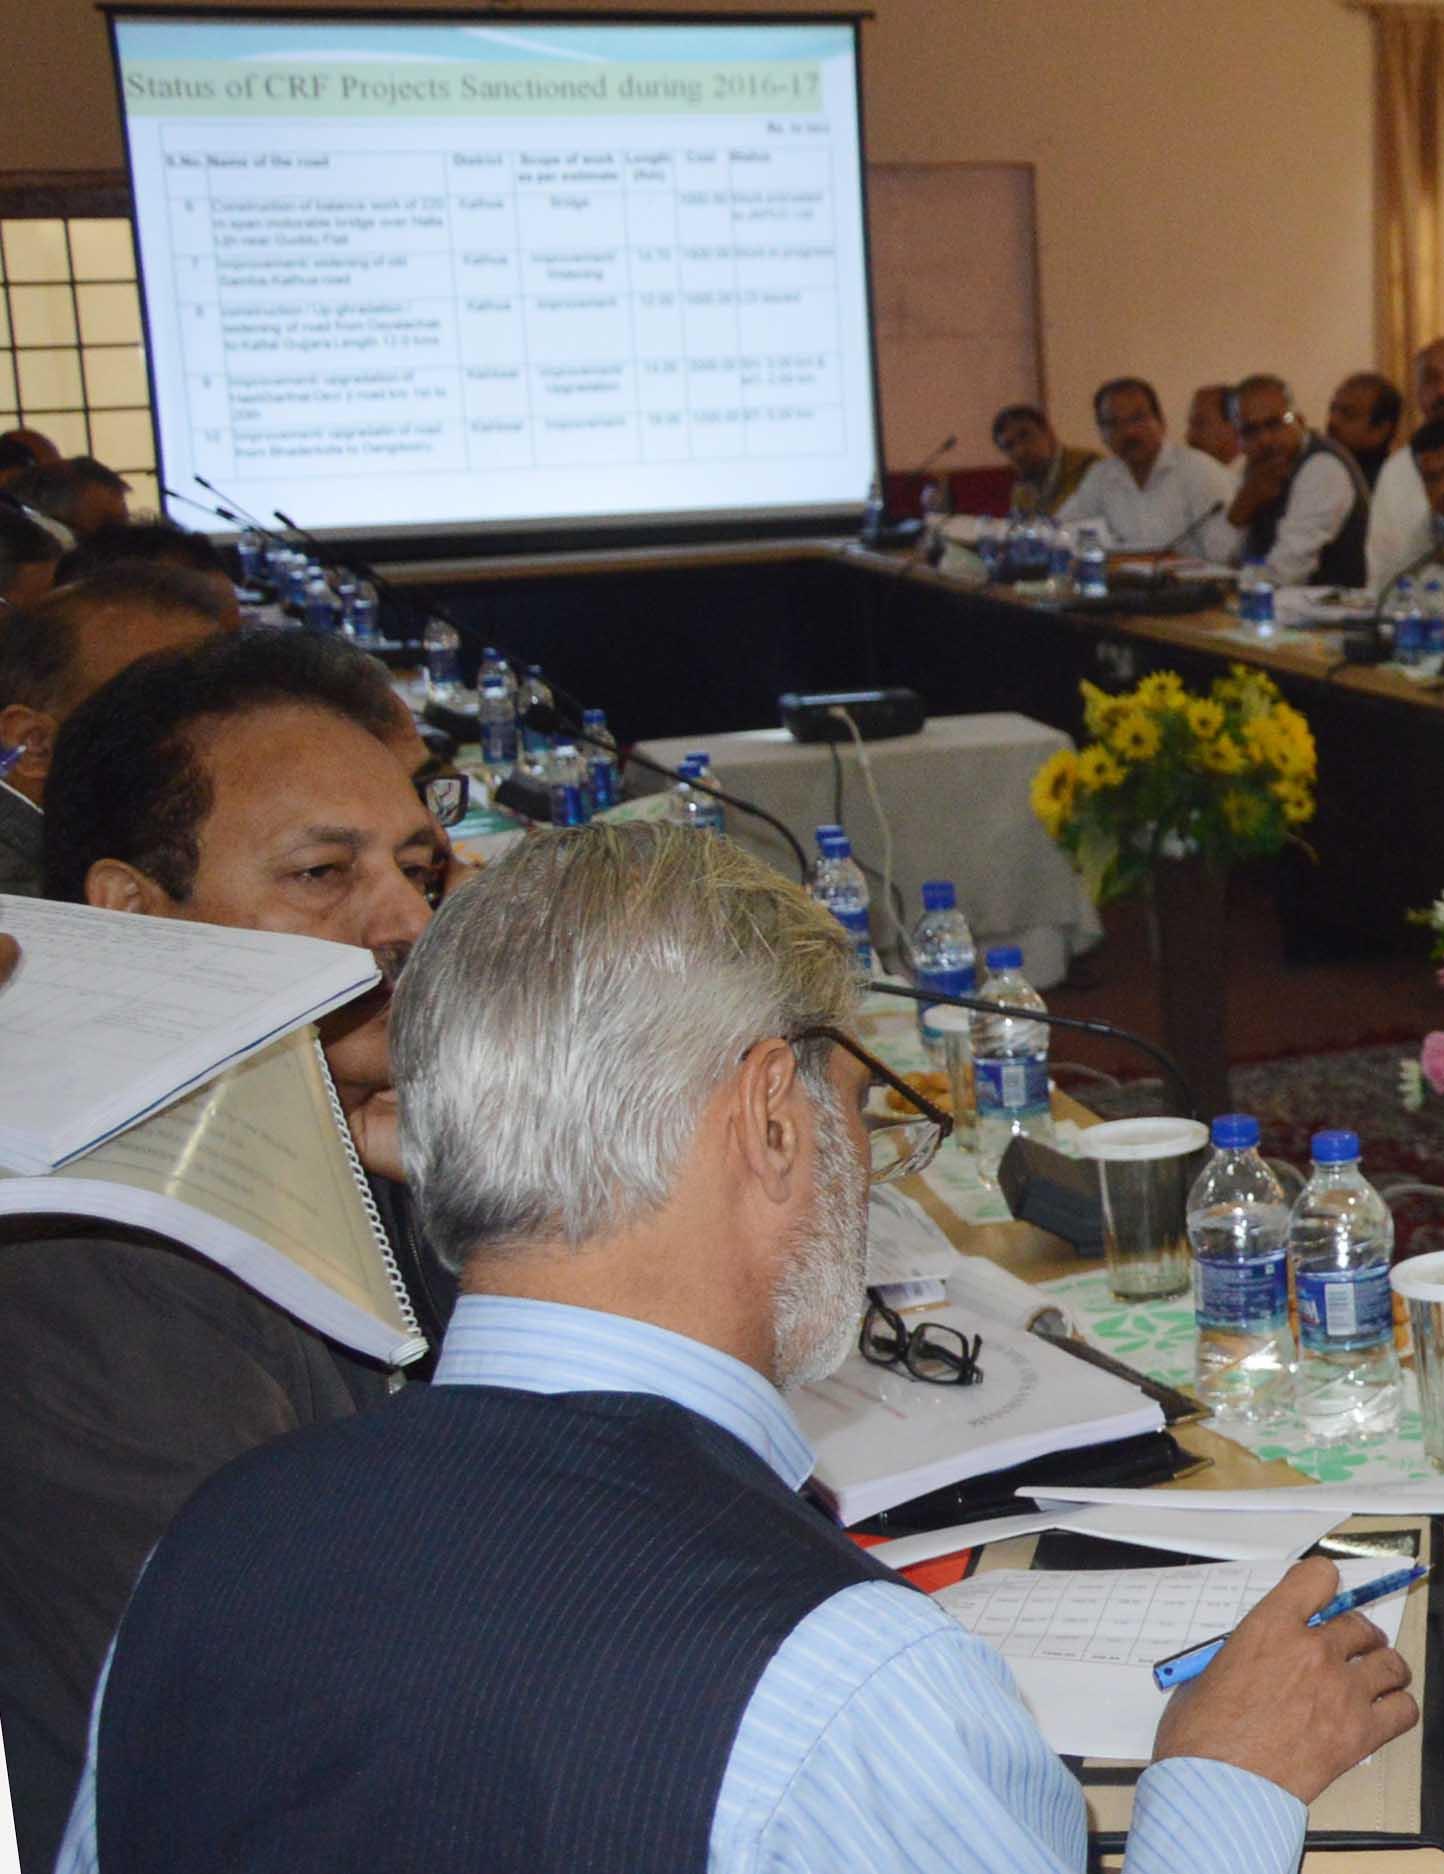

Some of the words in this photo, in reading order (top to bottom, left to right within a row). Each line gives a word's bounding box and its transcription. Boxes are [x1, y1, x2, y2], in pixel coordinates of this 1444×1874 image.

[126, 73, 216, 100] Status
[224, 73, 259, 100] of
[264, 73, 331, 99] CRF
[341, 73, 451, 105] Projects
[460, 72, 607, 100] Sanctioned
[617, 73, 702, 106] during
[712, 71, 821, 99] 2016-17
[207, 154, 247, 168] Name
[253, 154, 268, 168] of
[270, 154, 292, 168] the
[297, 155, 330, 168] road
[453, 151, 503, 166] District
[520, 152, 561, 167] Scope
[565, 152, 579, 166] of
[582, 152, 614, 166] work
